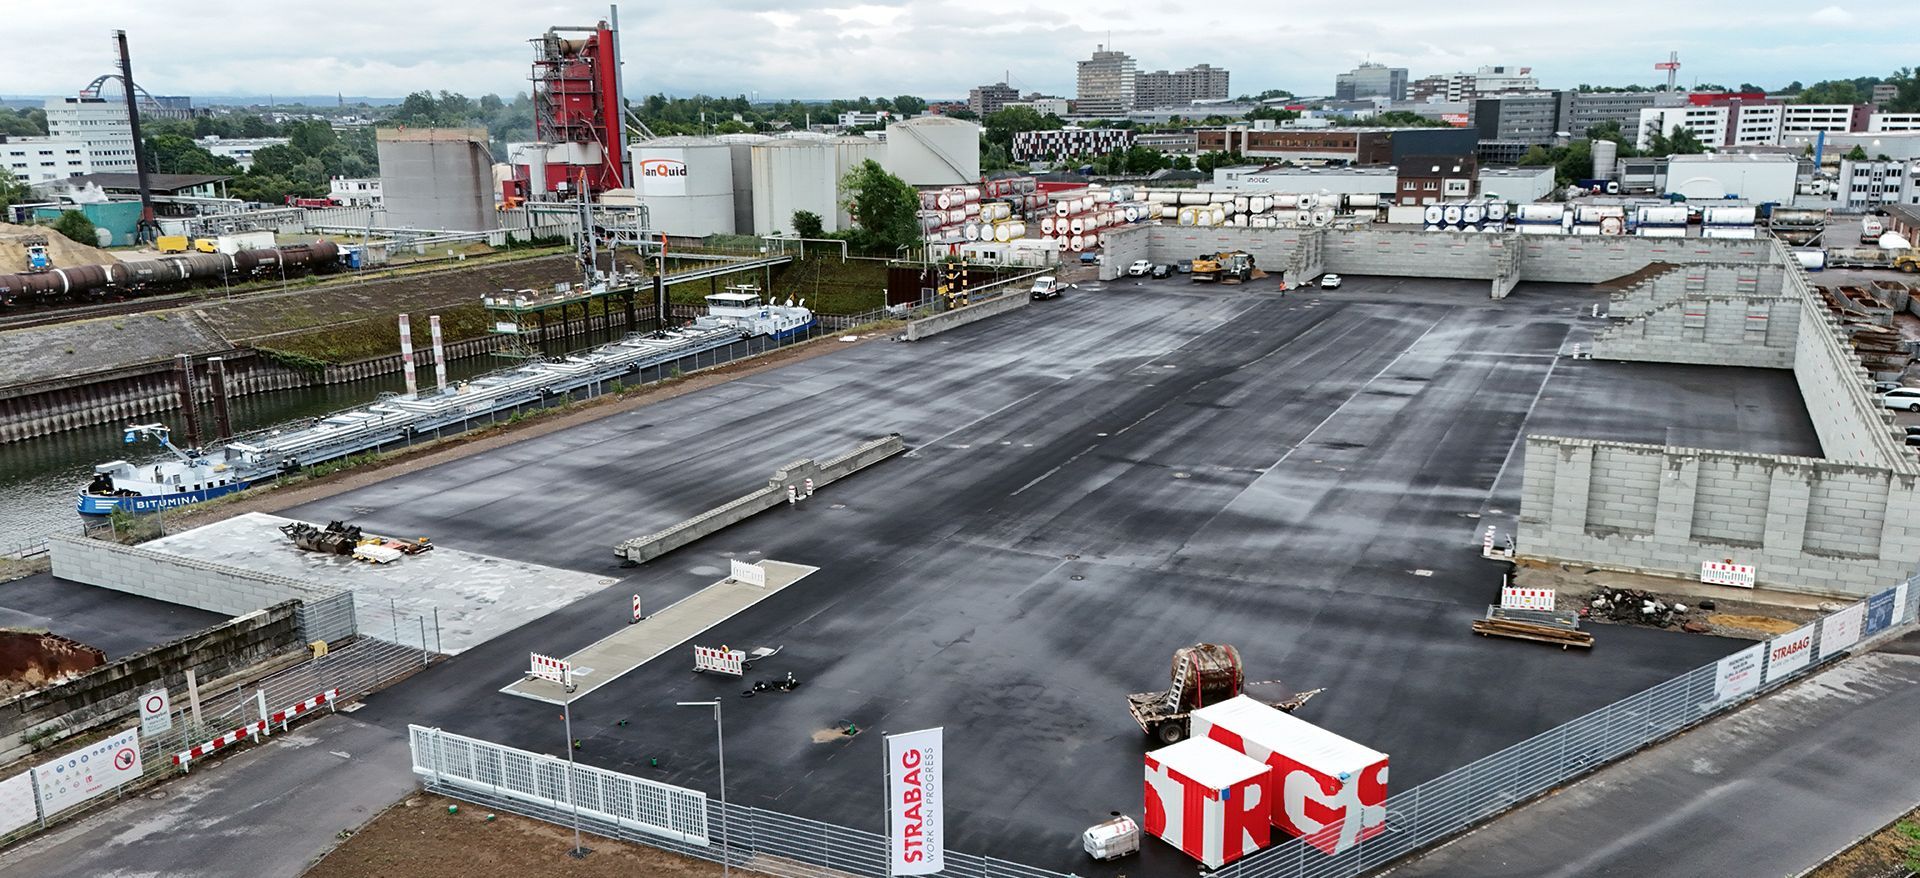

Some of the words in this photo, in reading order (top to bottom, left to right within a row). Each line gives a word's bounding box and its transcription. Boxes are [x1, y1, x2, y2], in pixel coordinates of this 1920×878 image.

[640, 159, 687, 177] TanQuid
[136, 495, 199, 509] BITUMINA
[1772, 636, 1810, 662] STRABAG
[924, 747, 934, 804] PROGRESS
[902, 749, 922, 863] STRABAG
[926, 810, 934, 827] ON
[926, 830, 934, 863] WORK
